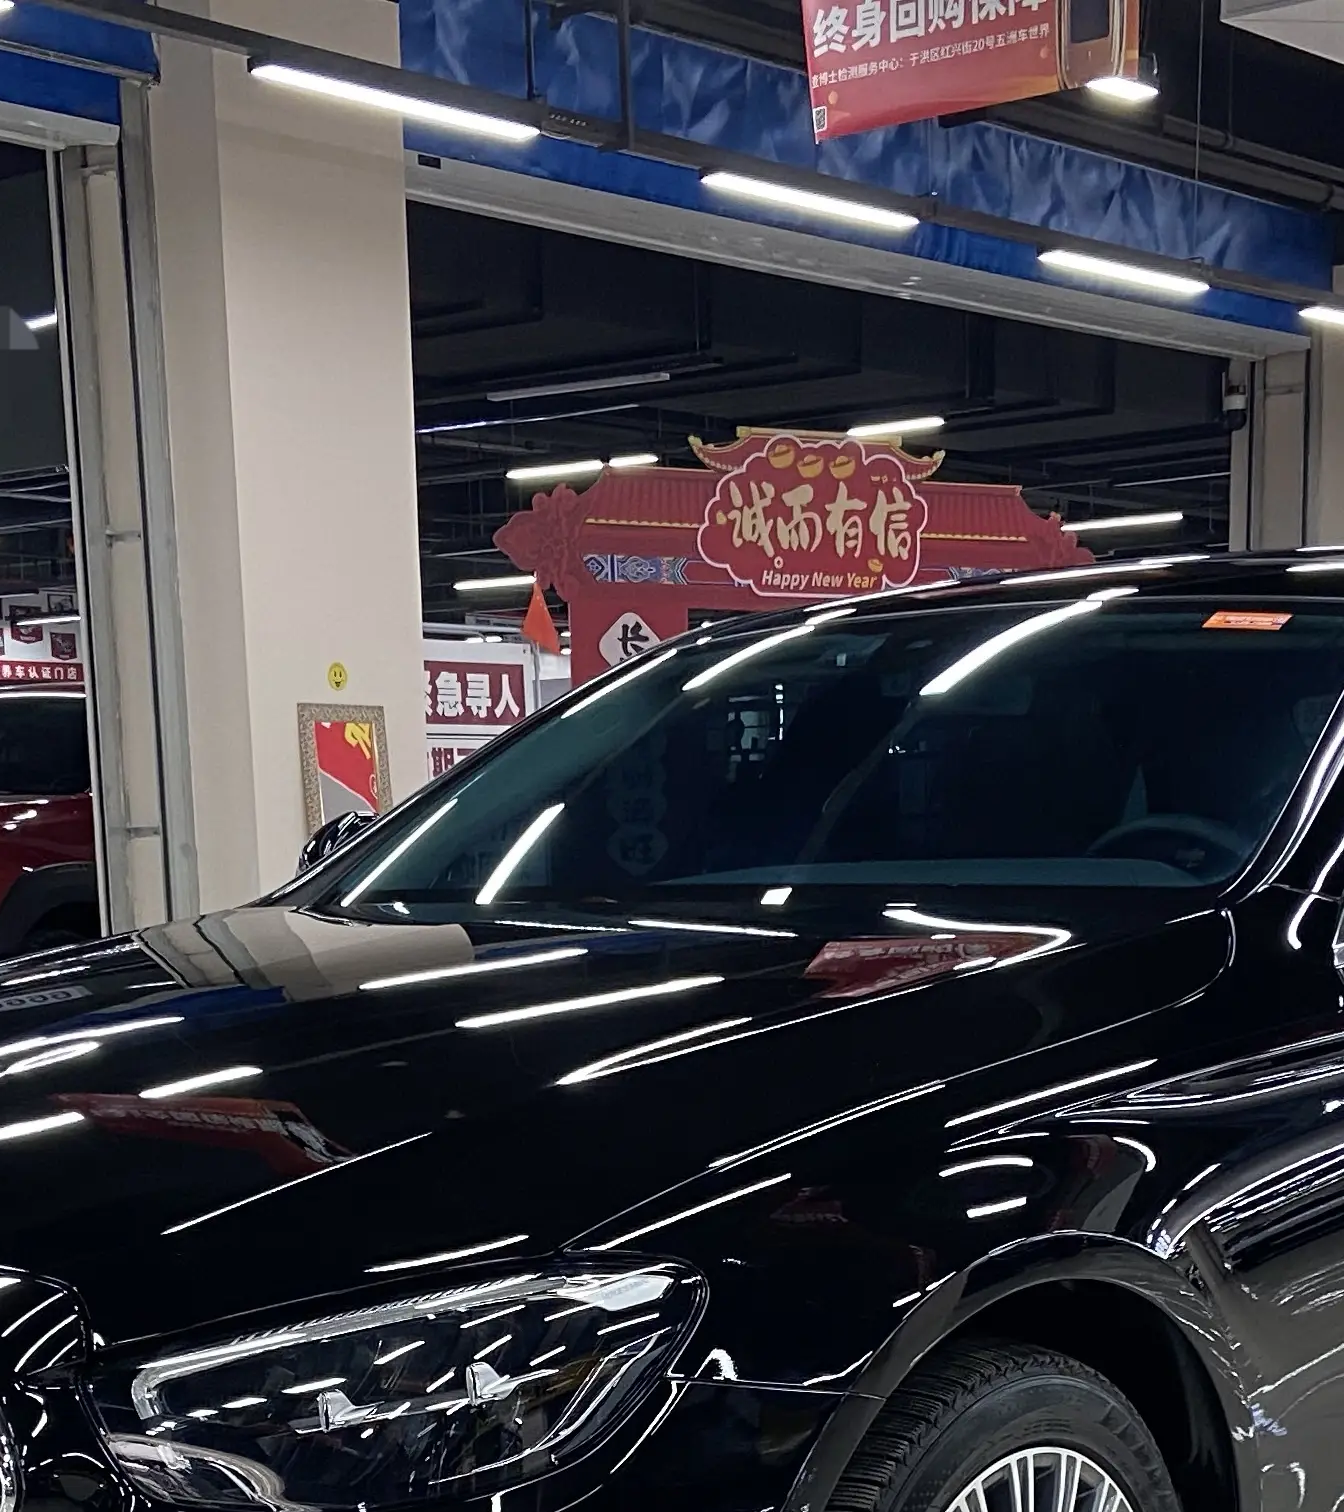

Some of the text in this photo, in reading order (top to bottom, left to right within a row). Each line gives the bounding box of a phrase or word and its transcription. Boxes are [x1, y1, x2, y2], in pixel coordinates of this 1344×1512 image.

[762, 571, 878, 591] Happy New Year
